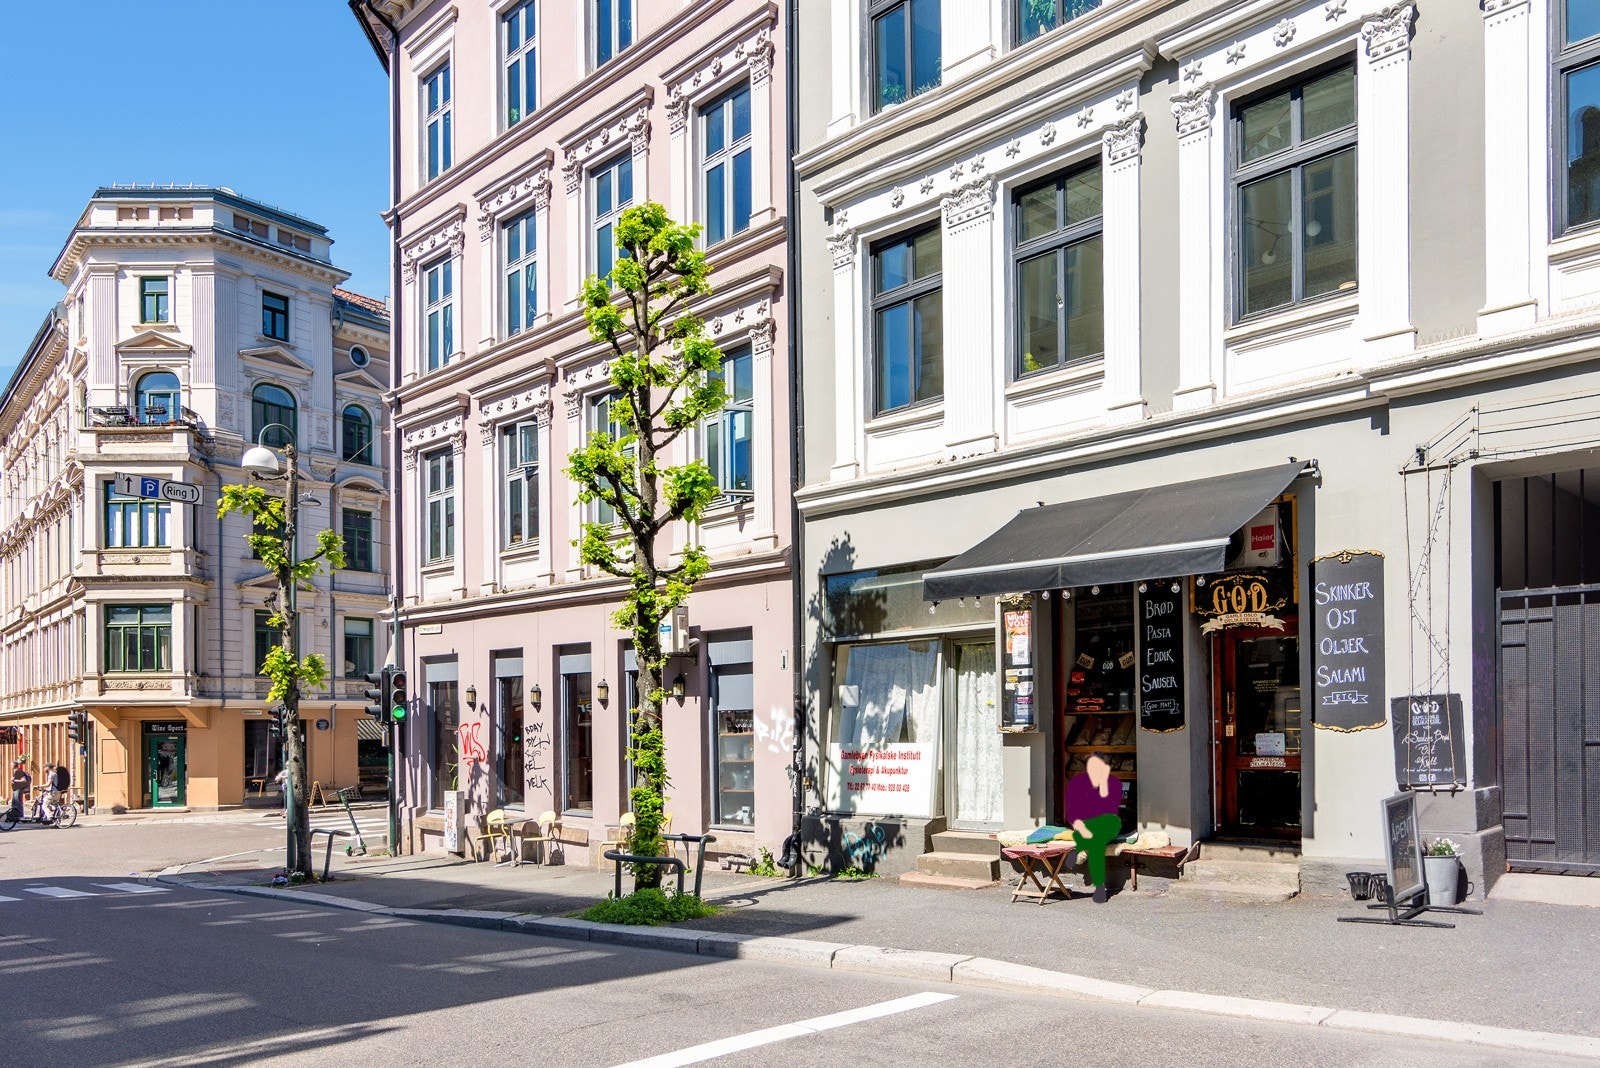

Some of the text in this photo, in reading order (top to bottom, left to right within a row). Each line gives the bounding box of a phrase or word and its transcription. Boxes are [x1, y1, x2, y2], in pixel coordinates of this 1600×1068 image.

[146, 484, 155, 496] P
[166, 486, 194, 500] Ring 1
[1251, 534, 1274, 542] Haier
[1315, 582, 1374, 605] SKINKER
[1146, 600, 1174, 619] BRØD
[1326, 608, 1357, 630] OST
[1147, 625, 1172, 641] PASTA
[1320, 637, 1369, 655] OLJER
[1147, 648, 1174, 666] EDDIK
[1142, 674, 1178, 692] SAUSER
[1317, 665, 1366, 688] SALAMI
[870, 750, 897, 762] Fysikalske
[898, 750, 921, 760] Institutt
[849, 766, 875, 776] Fysioterapi
[881, 766, 908, 776] Akupunktur
[1391, 816, 1413, 844] ÅPENT
